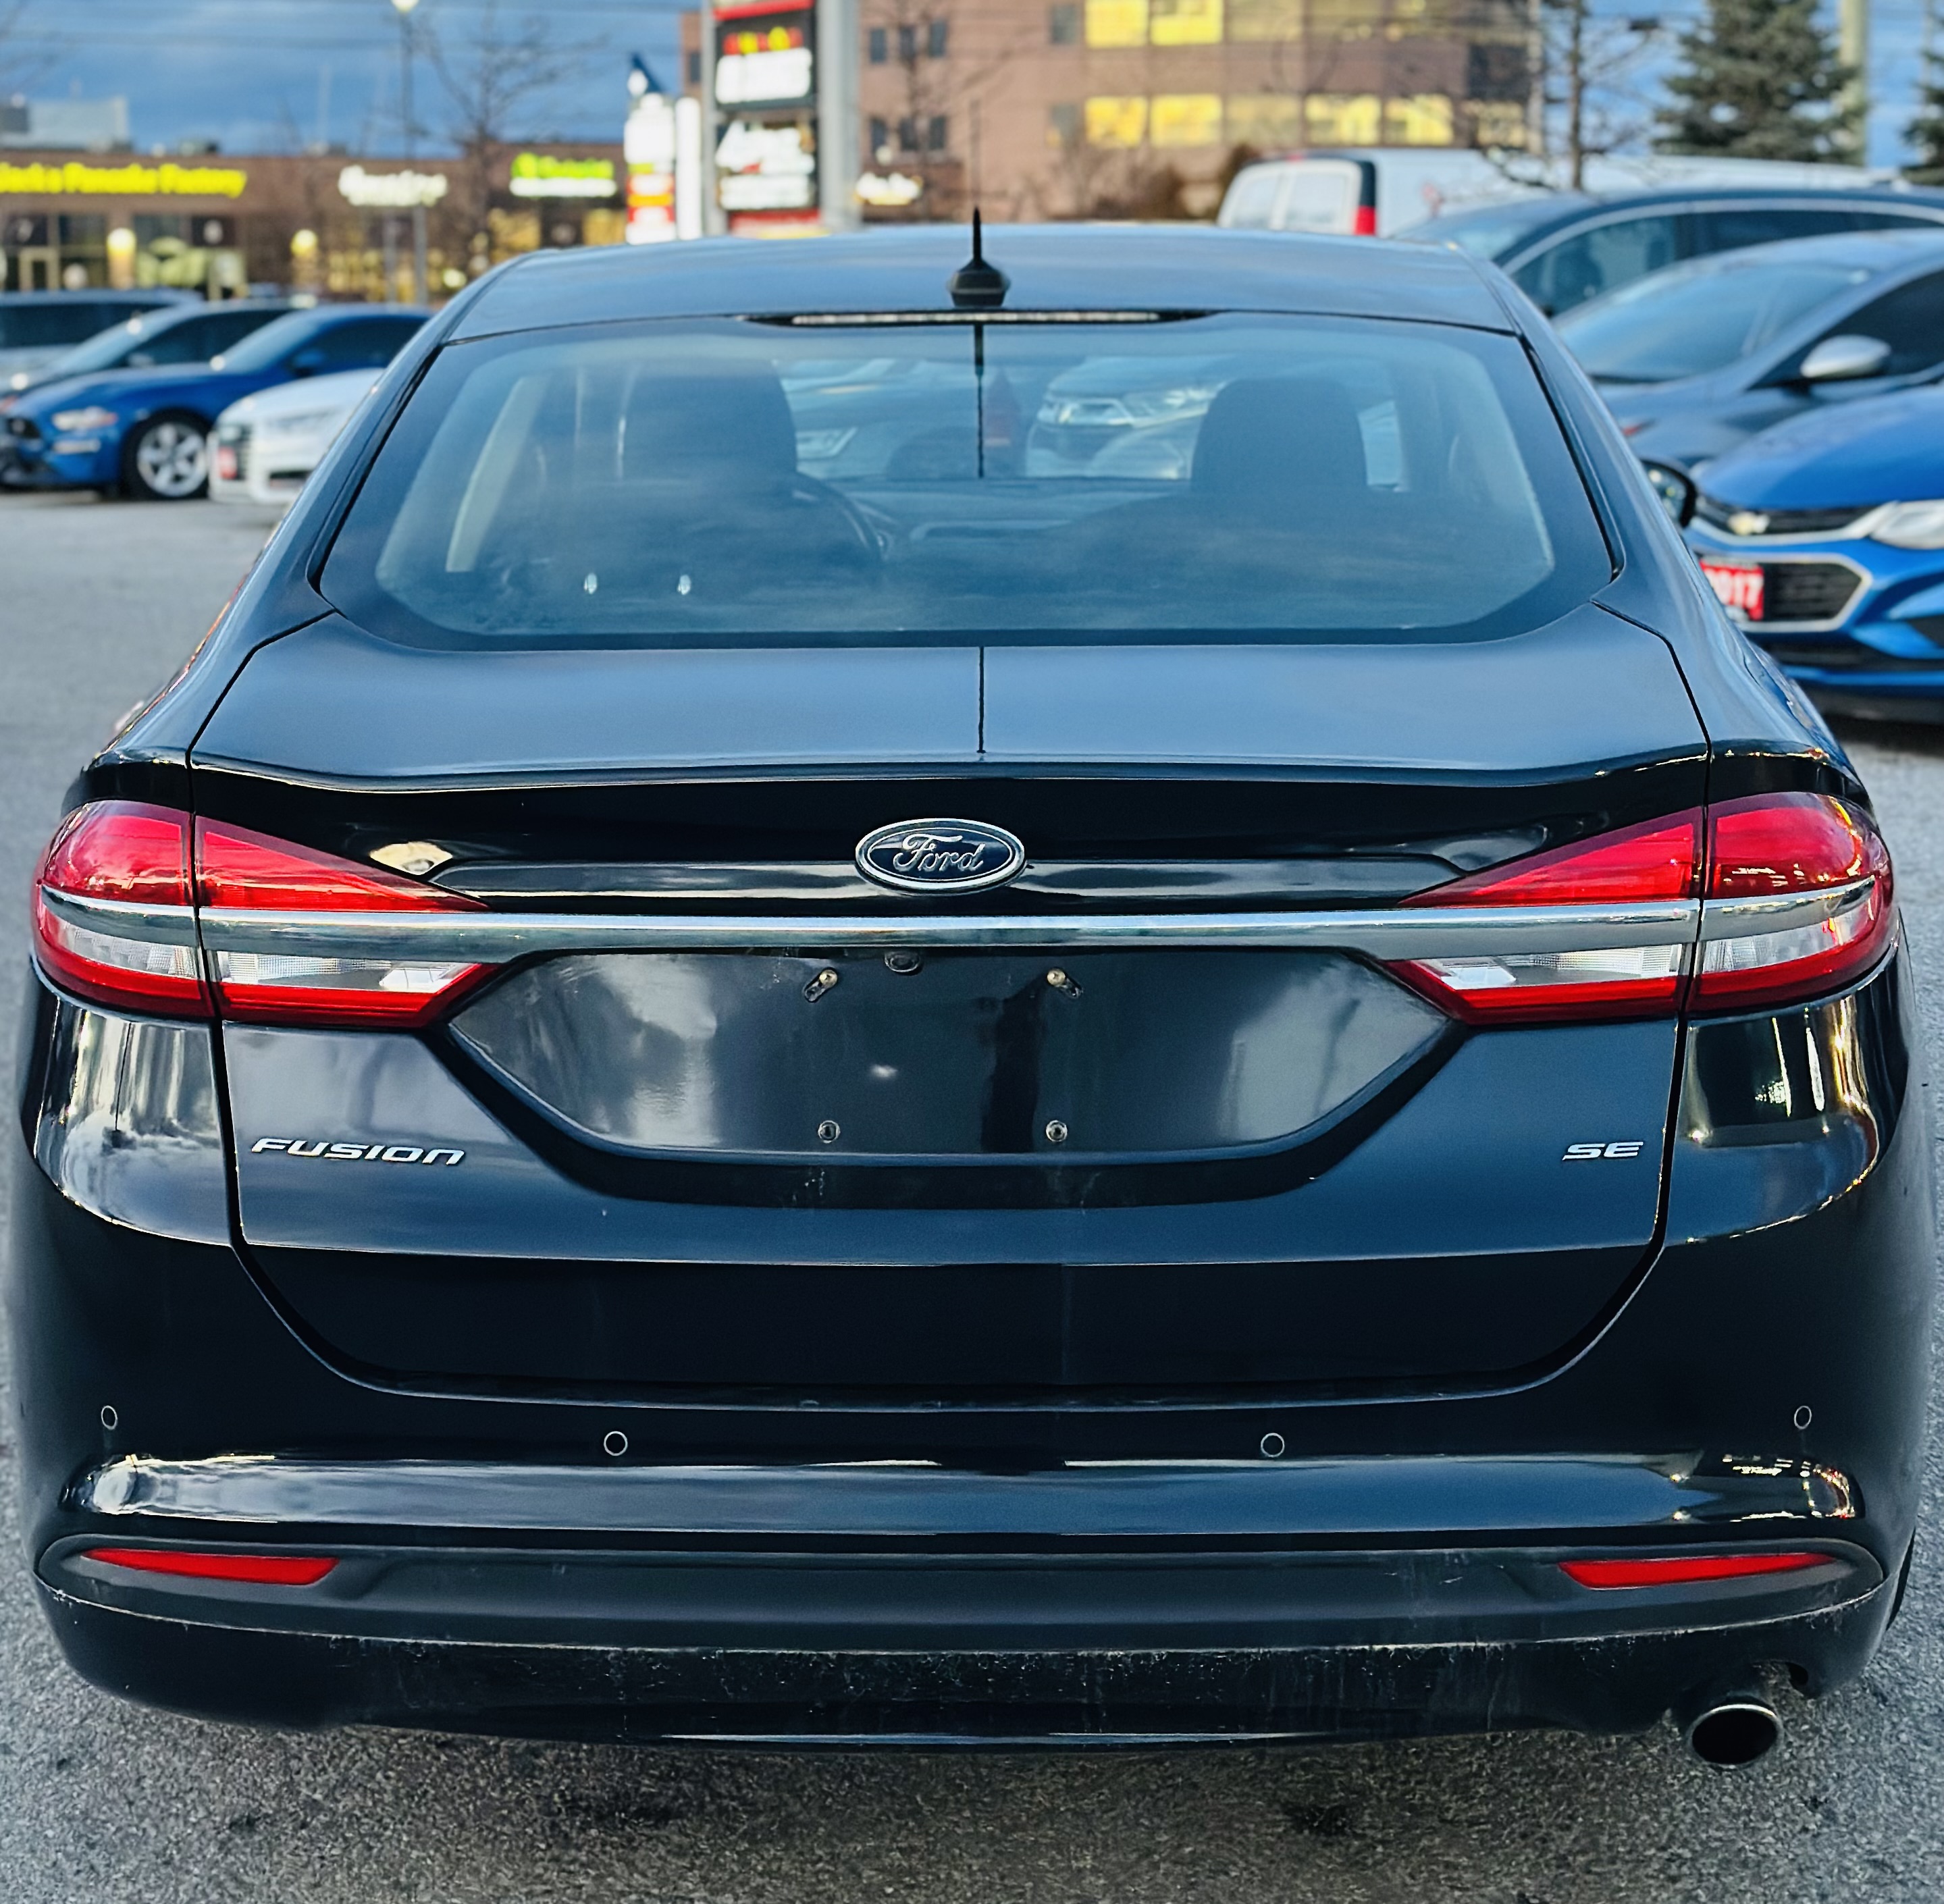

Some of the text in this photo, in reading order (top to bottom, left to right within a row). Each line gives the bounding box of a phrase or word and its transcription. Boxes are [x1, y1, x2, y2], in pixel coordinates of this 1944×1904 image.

[893, 833, 984, 872] Ford
[251, 1138, 465, 1165] FUSION
[1562, 1141, 1644, 1161] SE
